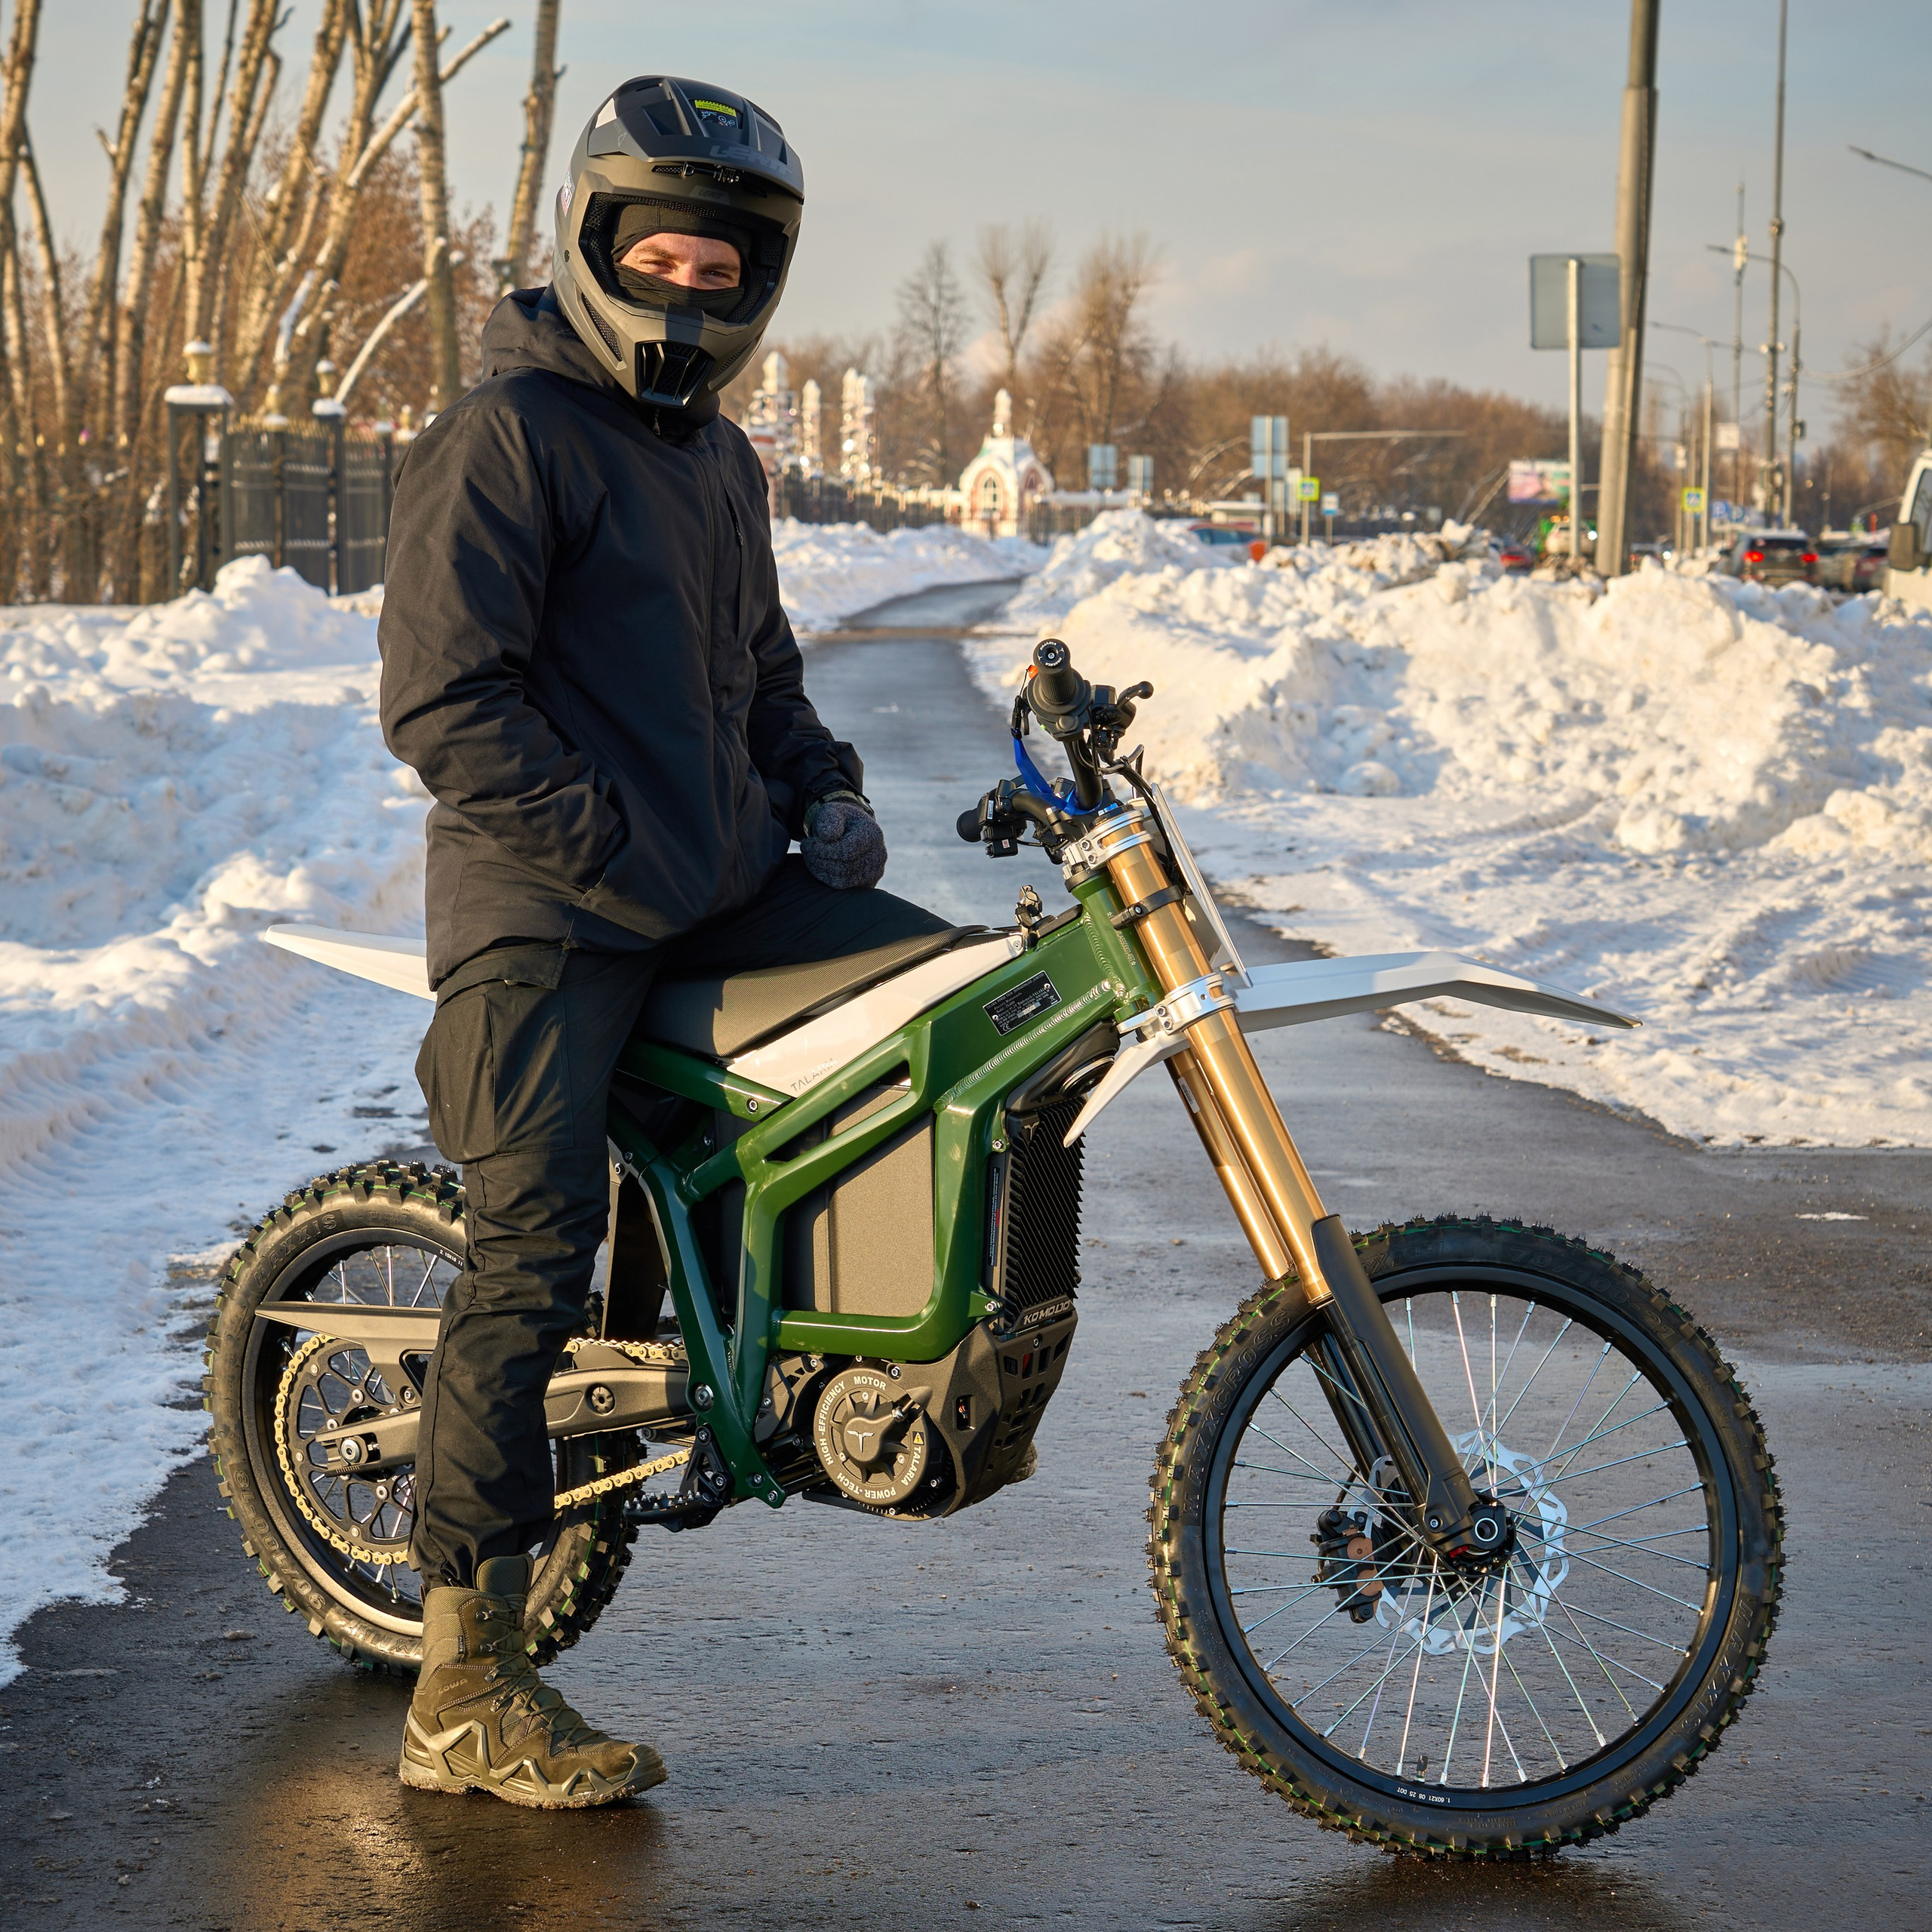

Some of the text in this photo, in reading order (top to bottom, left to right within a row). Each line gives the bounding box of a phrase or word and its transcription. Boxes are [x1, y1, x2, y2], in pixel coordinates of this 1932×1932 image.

[709, 145, 792, 177] LEATT
[697, 189, 724, 200] LEATT
[790, 1057, 838, 1092] TALARIA
[254, 1213, 338, 1291] MAXXIS
[1510, 1247, 1675, 1341] 70/100-21
[854, 1376, 887, 1391] MOTOR
[1183, 1309, 1291, 1516] MAXXCROSS
[901, 1446, 921, 1486] TALARIA
[231, 1468, 328, 1611] 90/100-18
[1682, 1599, 1754, 1736] MAXXIS
[1396, 1786, 1407, 1795] DOT
